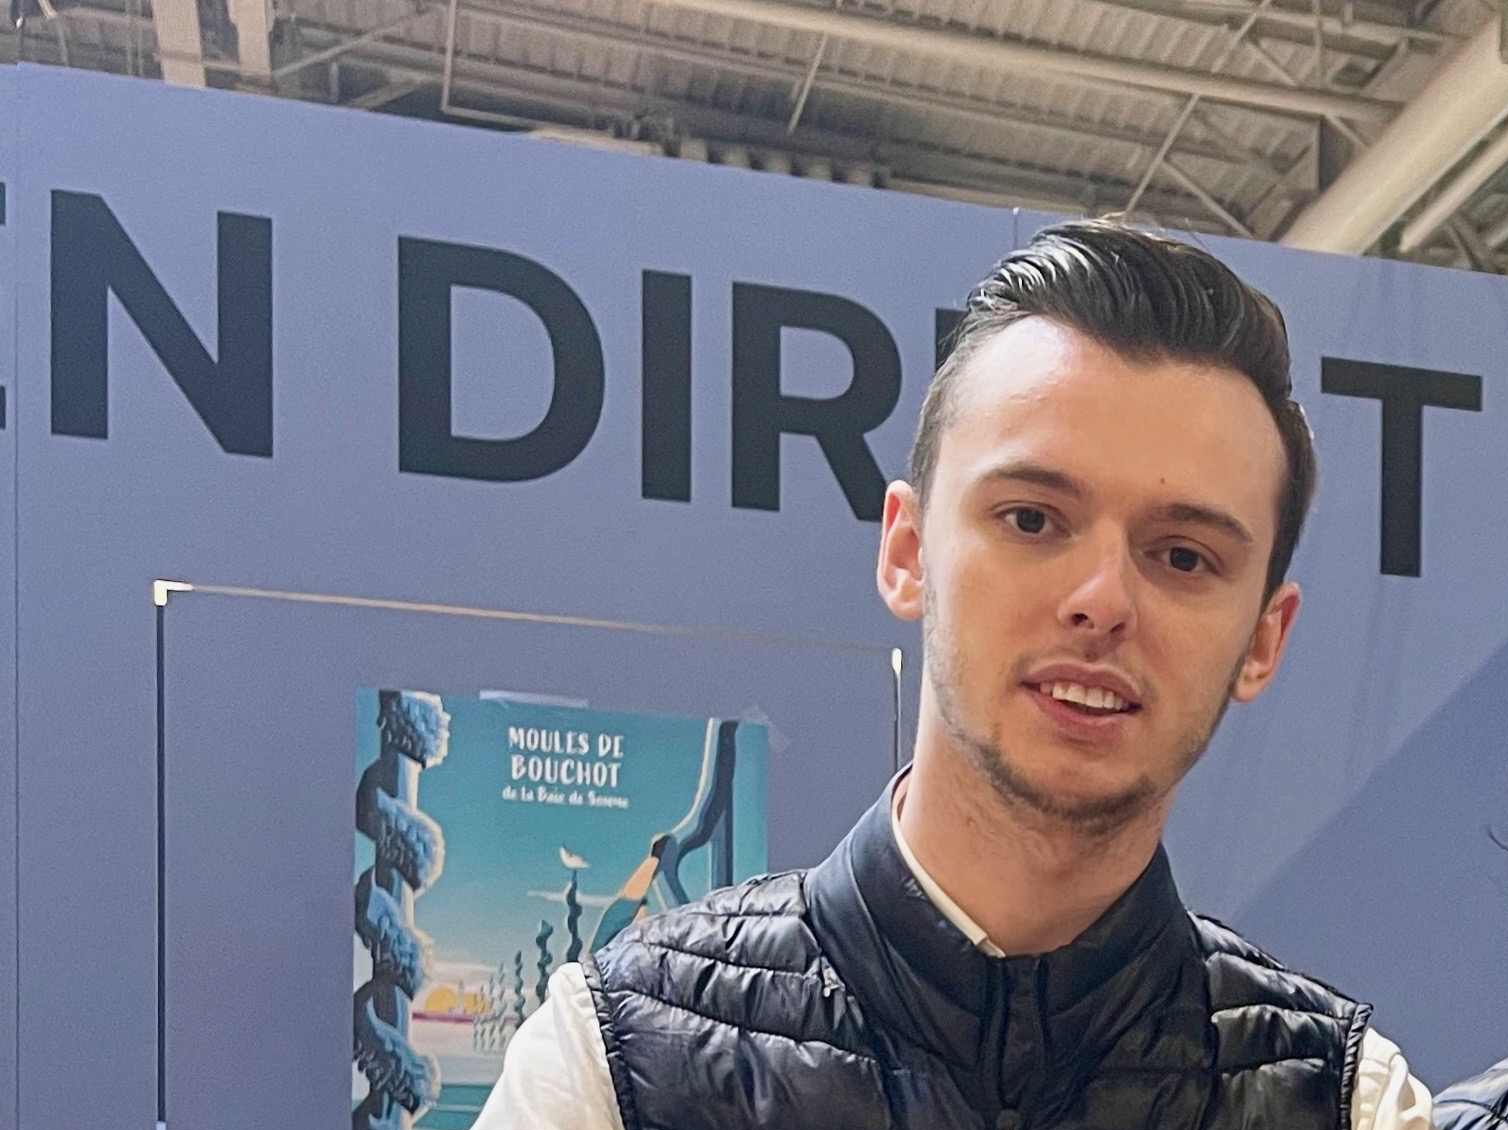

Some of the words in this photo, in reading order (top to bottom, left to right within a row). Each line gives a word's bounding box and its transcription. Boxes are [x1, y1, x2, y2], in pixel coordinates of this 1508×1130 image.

[0, 182, 273, 458] N
[398, 235, 1482, 578] DIRT
[508, 726, 590, 756] MOULES
[598, 733, 625, 759] DE
[511, 754, 621, 788] BOUCHOT
